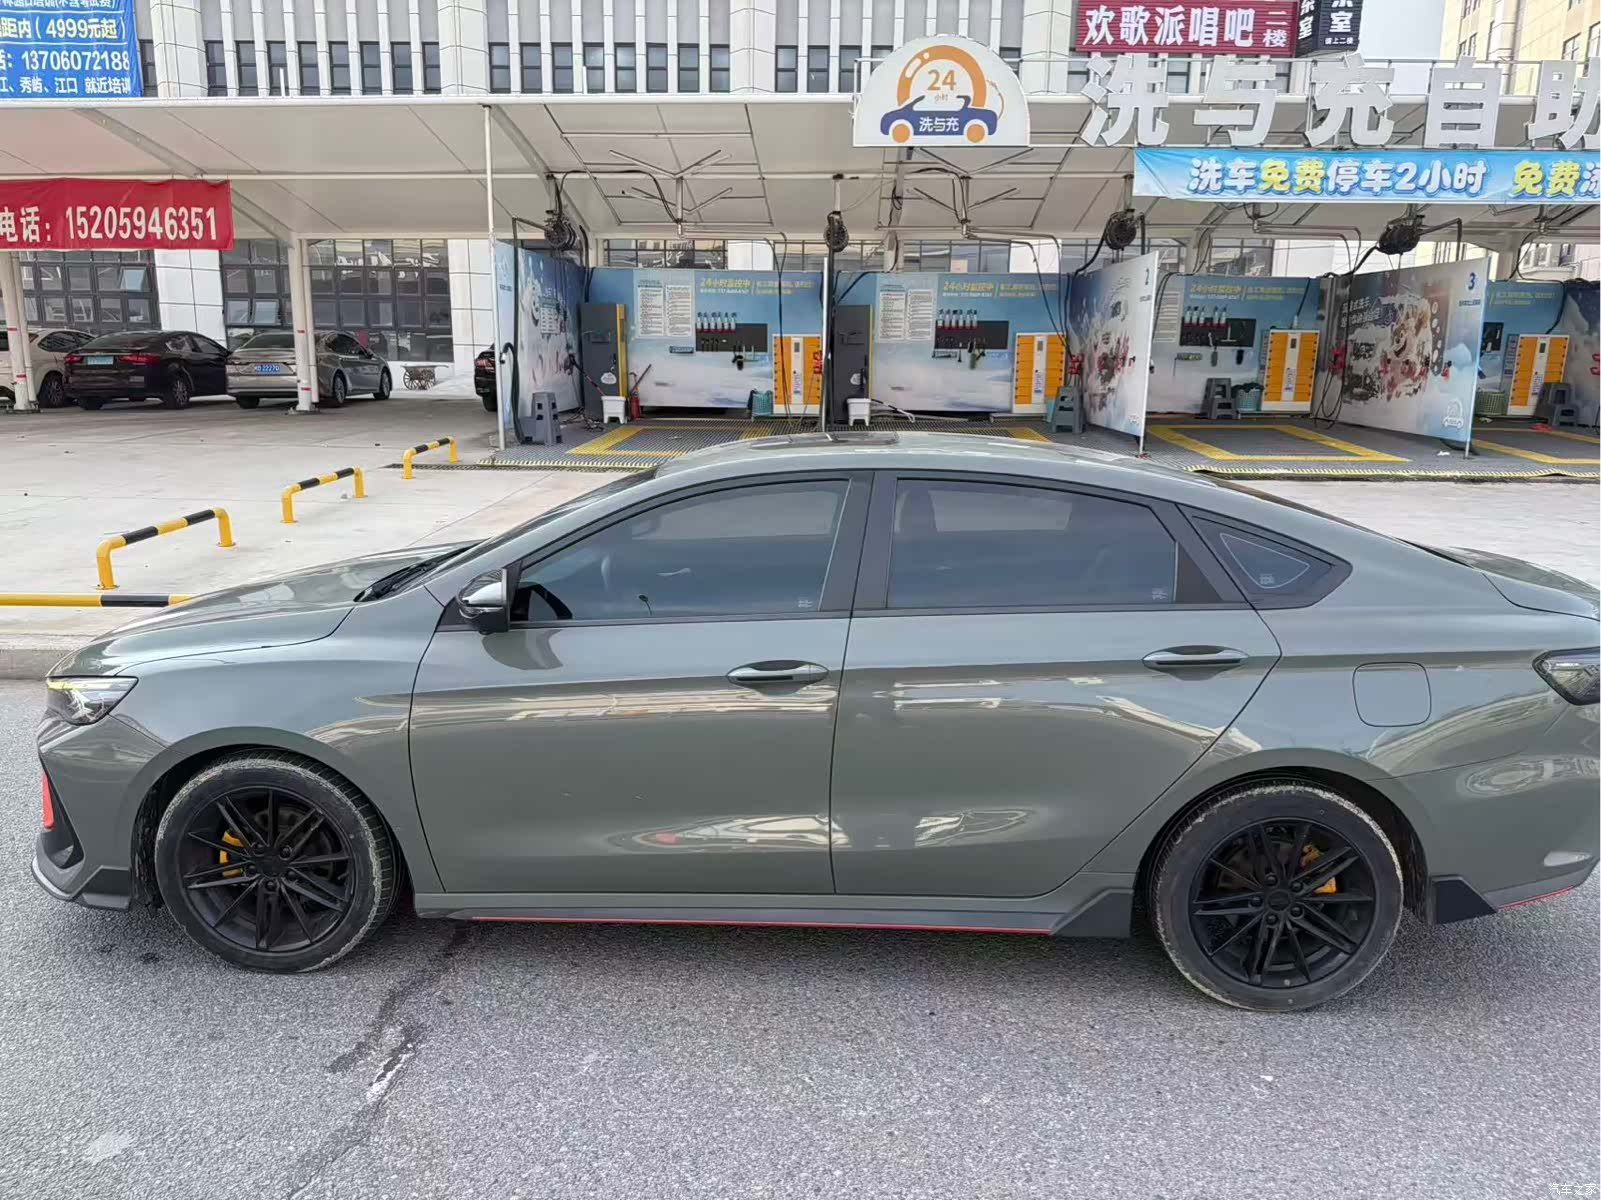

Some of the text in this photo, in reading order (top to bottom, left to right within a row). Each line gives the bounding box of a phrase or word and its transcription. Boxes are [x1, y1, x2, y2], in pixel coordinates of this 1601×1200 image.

[1083, 5, 1256, 48] 欢歌派唱吧
[1263, 10, 1288, 48] 二楼
[927, 69, 957, 91] 24
[1080, 53, 1600, 149] 洗与充自助
[919, 116, 960, 132] 洗与充
[1188, 158, 1488, 194] 洗车免费停车2小时
[1467, 271, 1477, 291] 3
